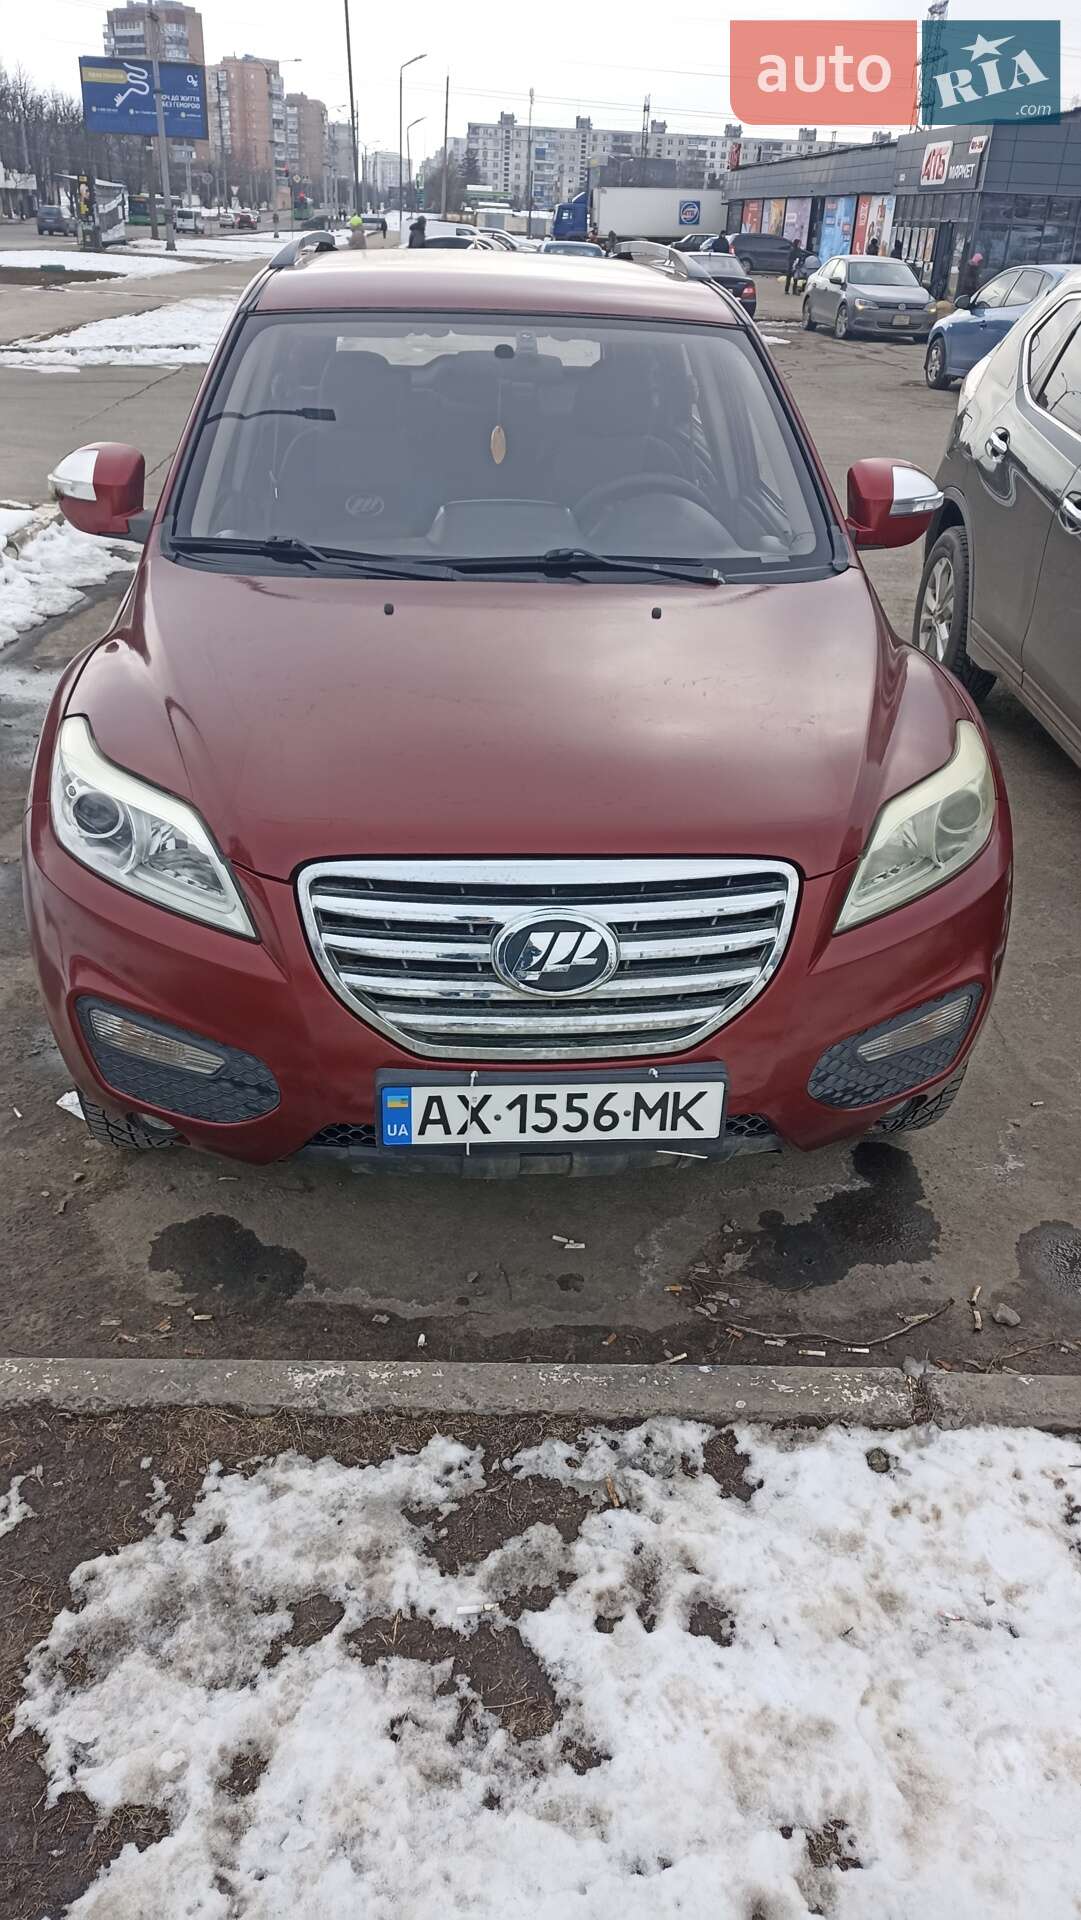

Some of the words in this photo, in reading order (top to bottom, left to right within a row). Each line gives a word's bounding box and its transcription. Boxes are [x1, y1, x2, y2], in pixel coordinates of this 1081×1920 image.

[417, 1094, 493, 1136] AX
[505, 1092, 618, 1134] 1556
[631, 1090, 708, 1132] MK
[387, 1123, 409, 1136] UA
